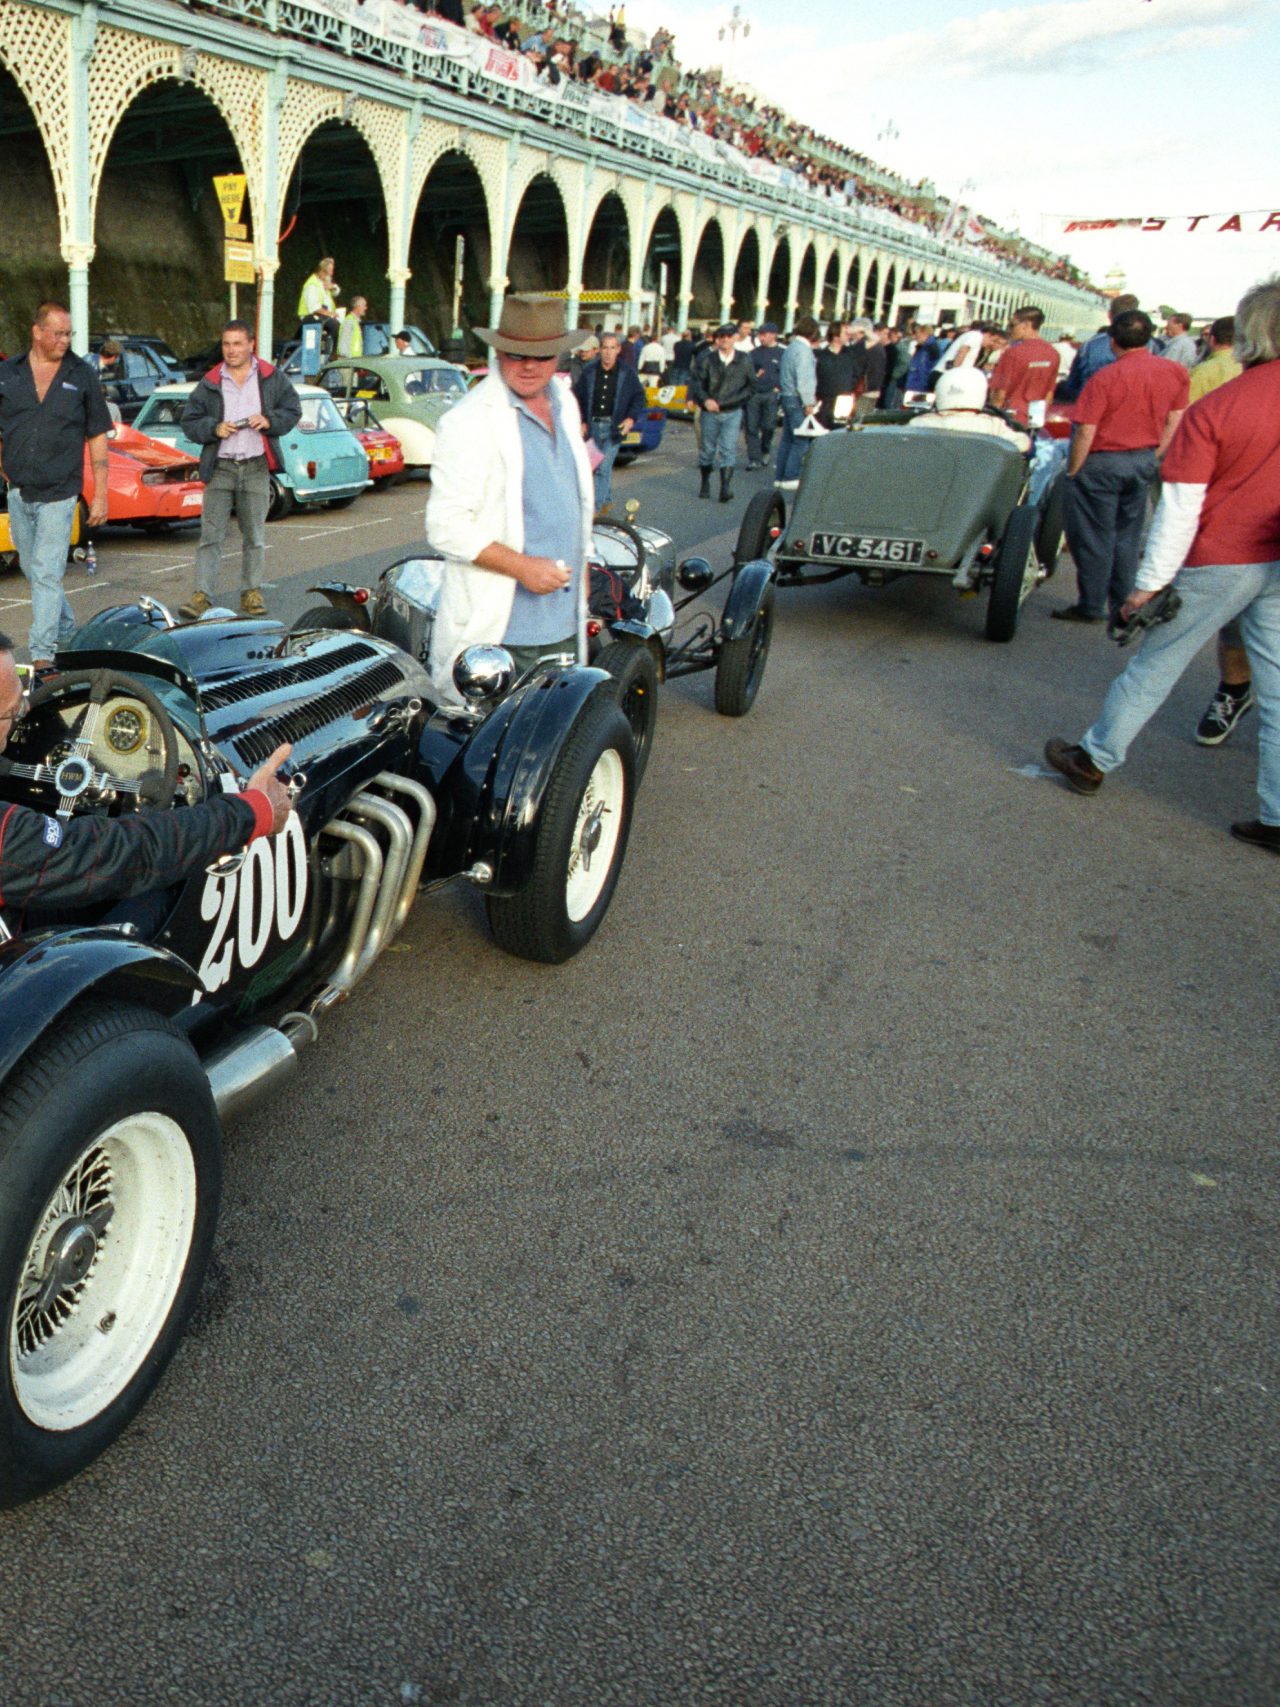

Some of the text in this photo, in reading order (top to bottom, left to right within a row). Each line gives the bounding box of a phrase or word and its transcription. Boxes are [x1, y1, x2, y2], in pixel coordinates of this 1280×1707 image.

[822, 536, 915, 562] VC 5461
[191, 808, 308, 1007] 200
